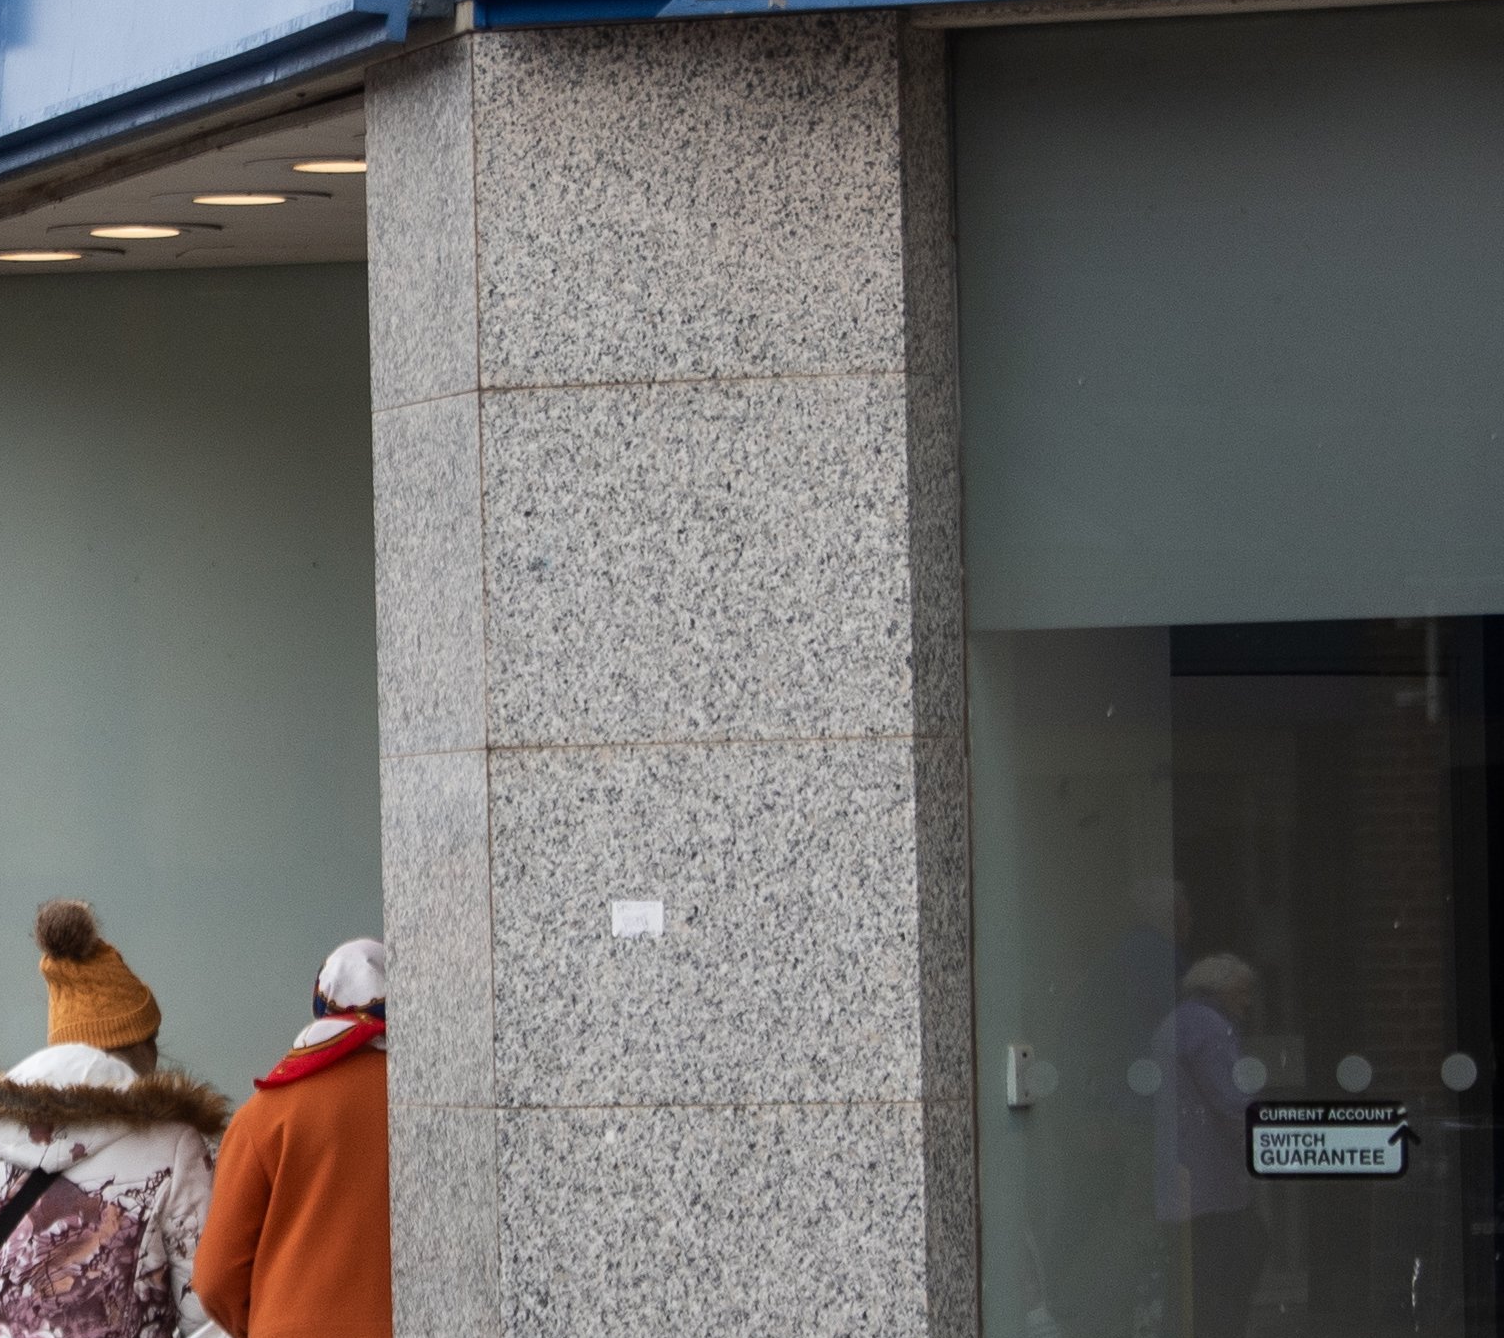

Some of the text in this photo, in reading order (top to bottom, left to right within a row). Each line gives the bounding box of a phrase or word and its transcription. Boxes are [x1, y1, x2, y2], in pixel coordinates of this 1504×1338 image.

[1259, 1108, 1392, 1121] CURRENT ACCOUNT
[1259, 1132, 1326, 1148] SWITCH
[1259, 1148, 1385, 1166] GUARANTEE
